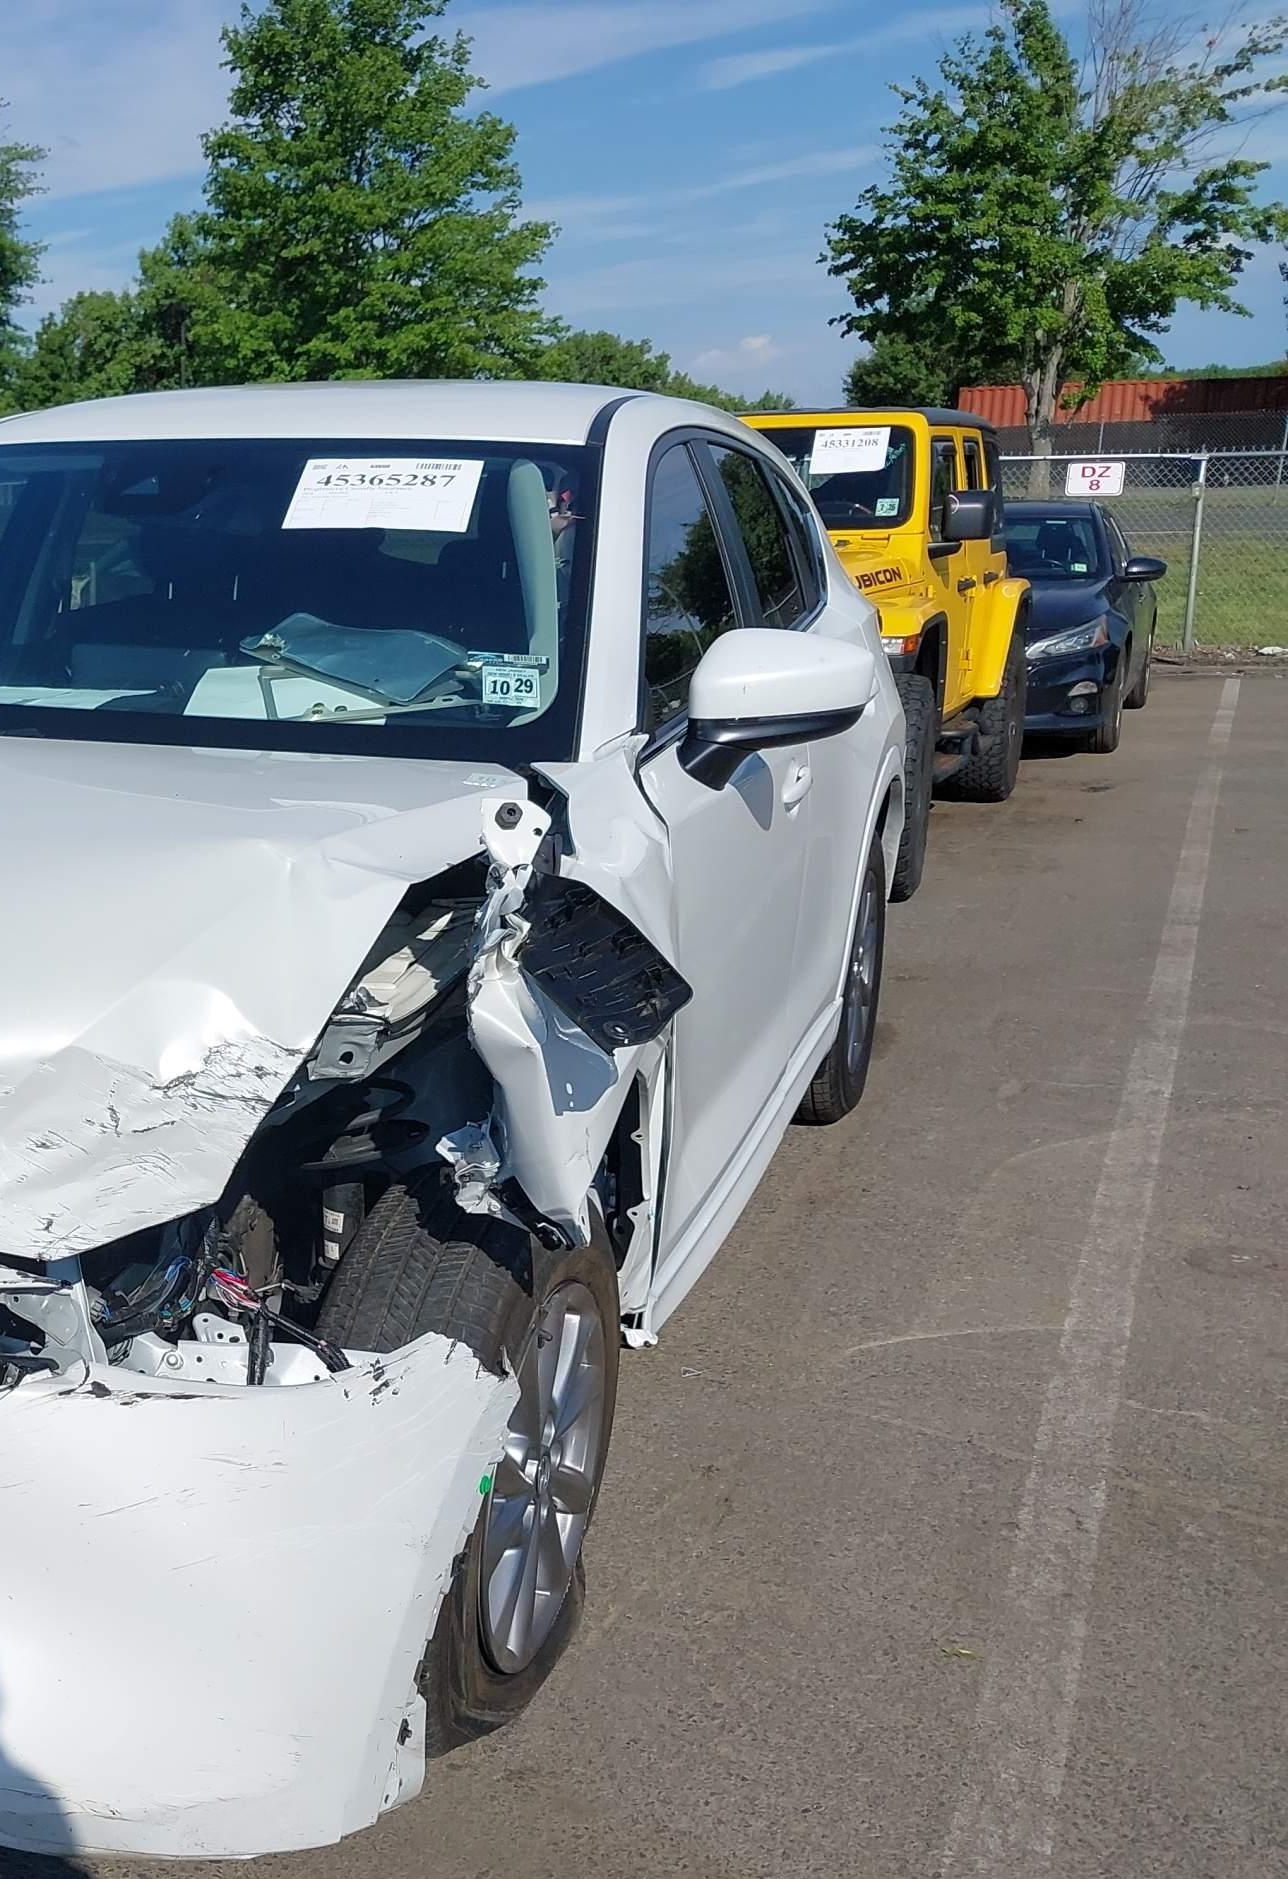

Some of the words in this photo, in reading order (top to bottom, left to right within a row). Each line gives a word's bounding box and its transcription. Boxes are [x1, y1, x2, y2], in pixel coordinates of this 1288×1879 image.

[820, 438, 880, 449] 45331208
[1081, 465, 1112, 478] DZ
[316, 473, 457, 488] 45365287
[1088, 479, 1101, 491] 8
[490, 679, 510, 695] 10
[513, 678, 533, 694] 29
